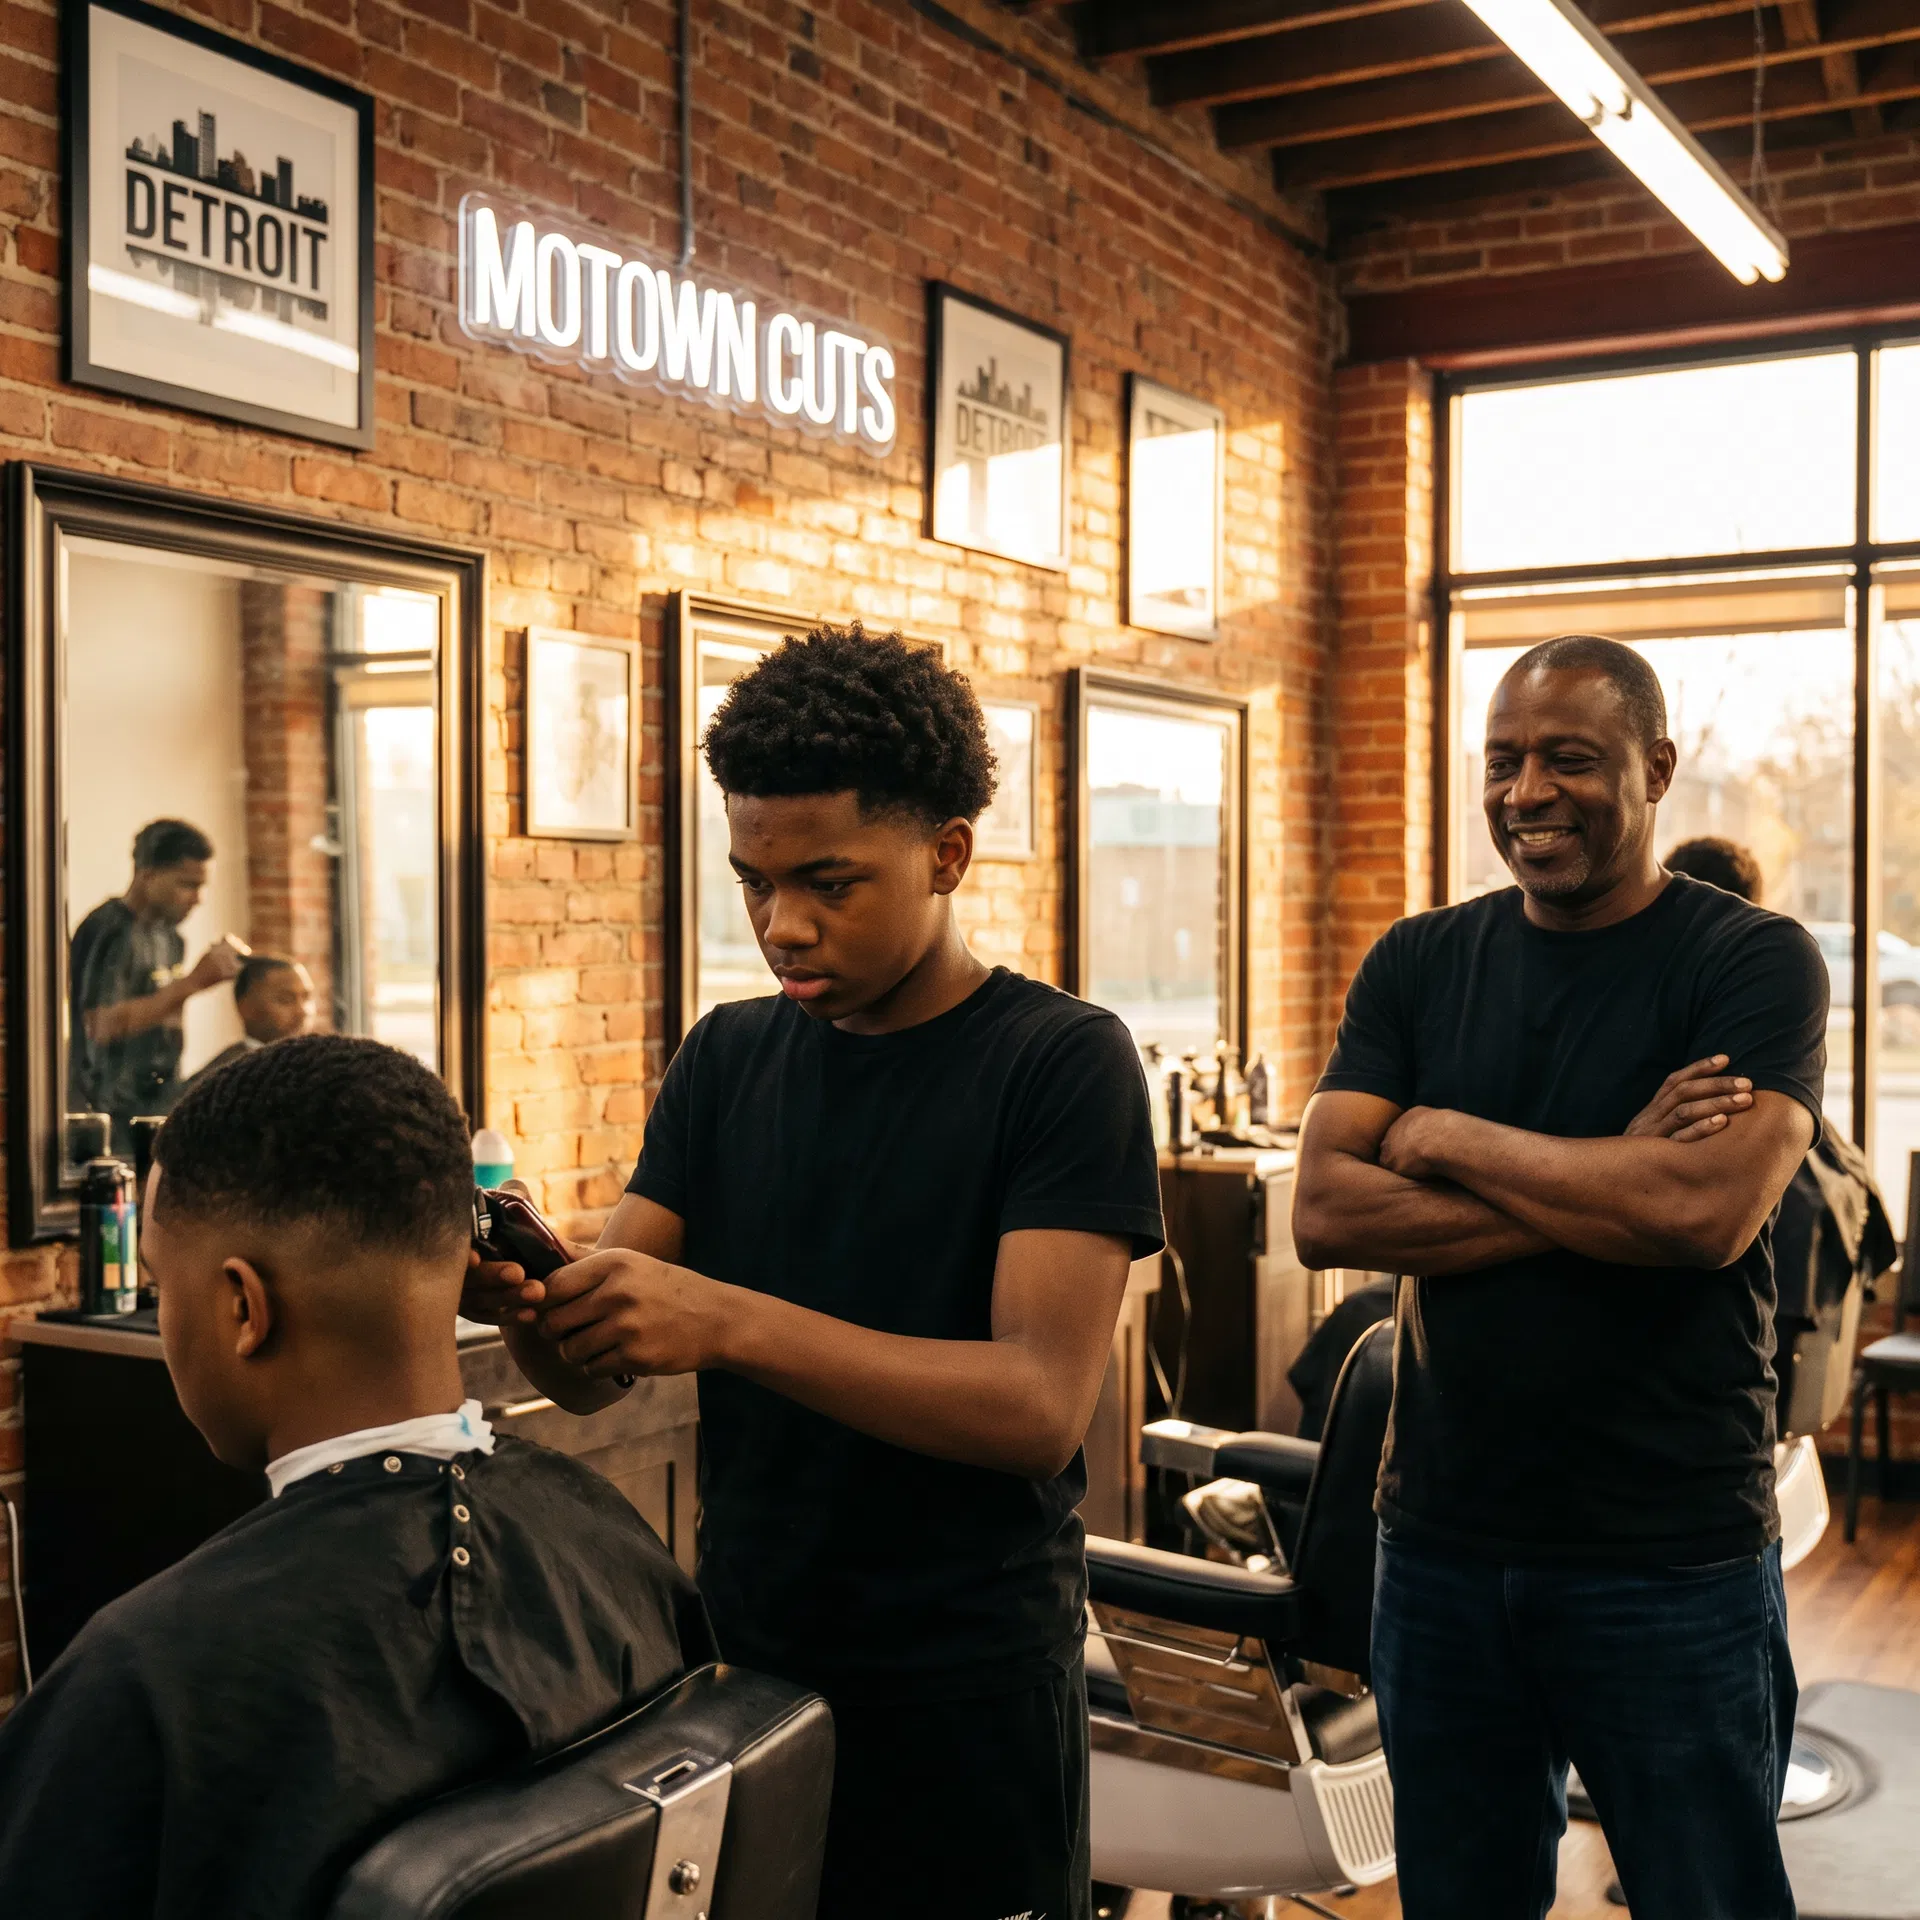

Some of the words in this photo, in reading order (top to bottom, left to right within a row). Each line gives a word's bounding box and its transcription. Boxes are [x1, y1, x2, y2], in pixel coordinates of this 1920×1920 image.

[126, 168, 328, 291] DETROIT
[474, 206, 757, 403] MOTOWN
[766, 312, 896, 443] CUTS
